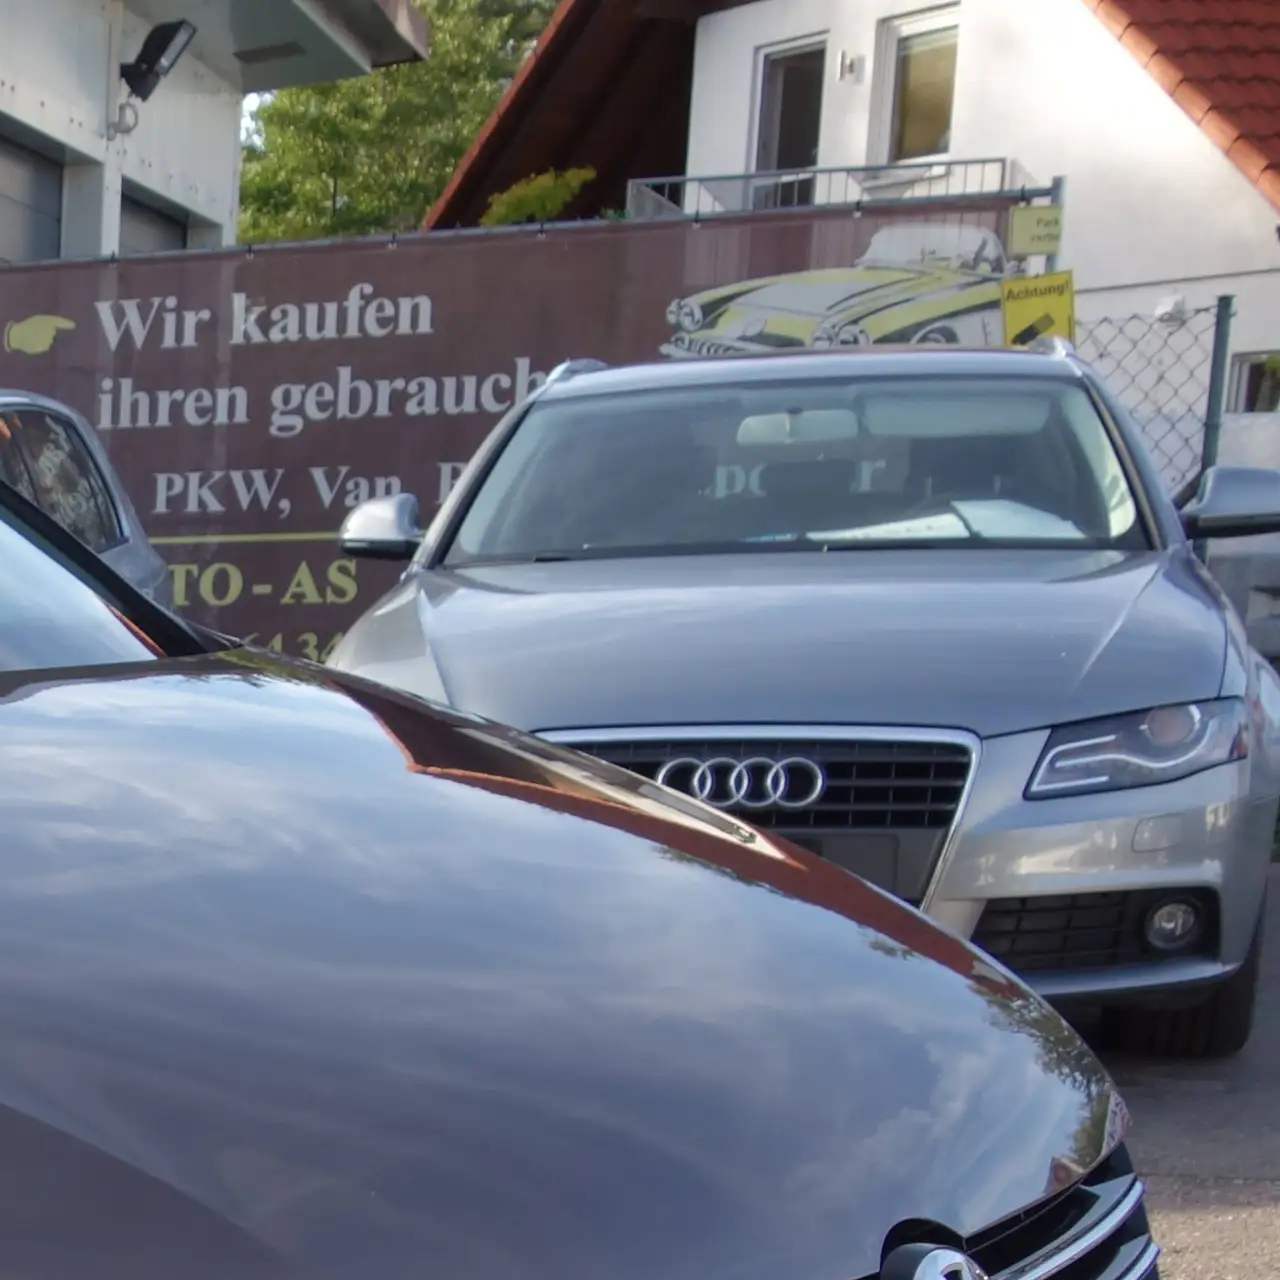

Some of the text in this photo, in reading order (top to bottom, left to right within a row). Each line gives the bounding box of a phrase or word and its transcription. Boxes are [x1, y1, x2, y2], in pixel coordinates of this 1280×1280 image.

[94, 282, 434, 351] Wir kaufen
[1006, 279, 1070, 301] Achtung!
[97, 376, 251, 430] ihren
[152, 467, 292, 519] PKW,
